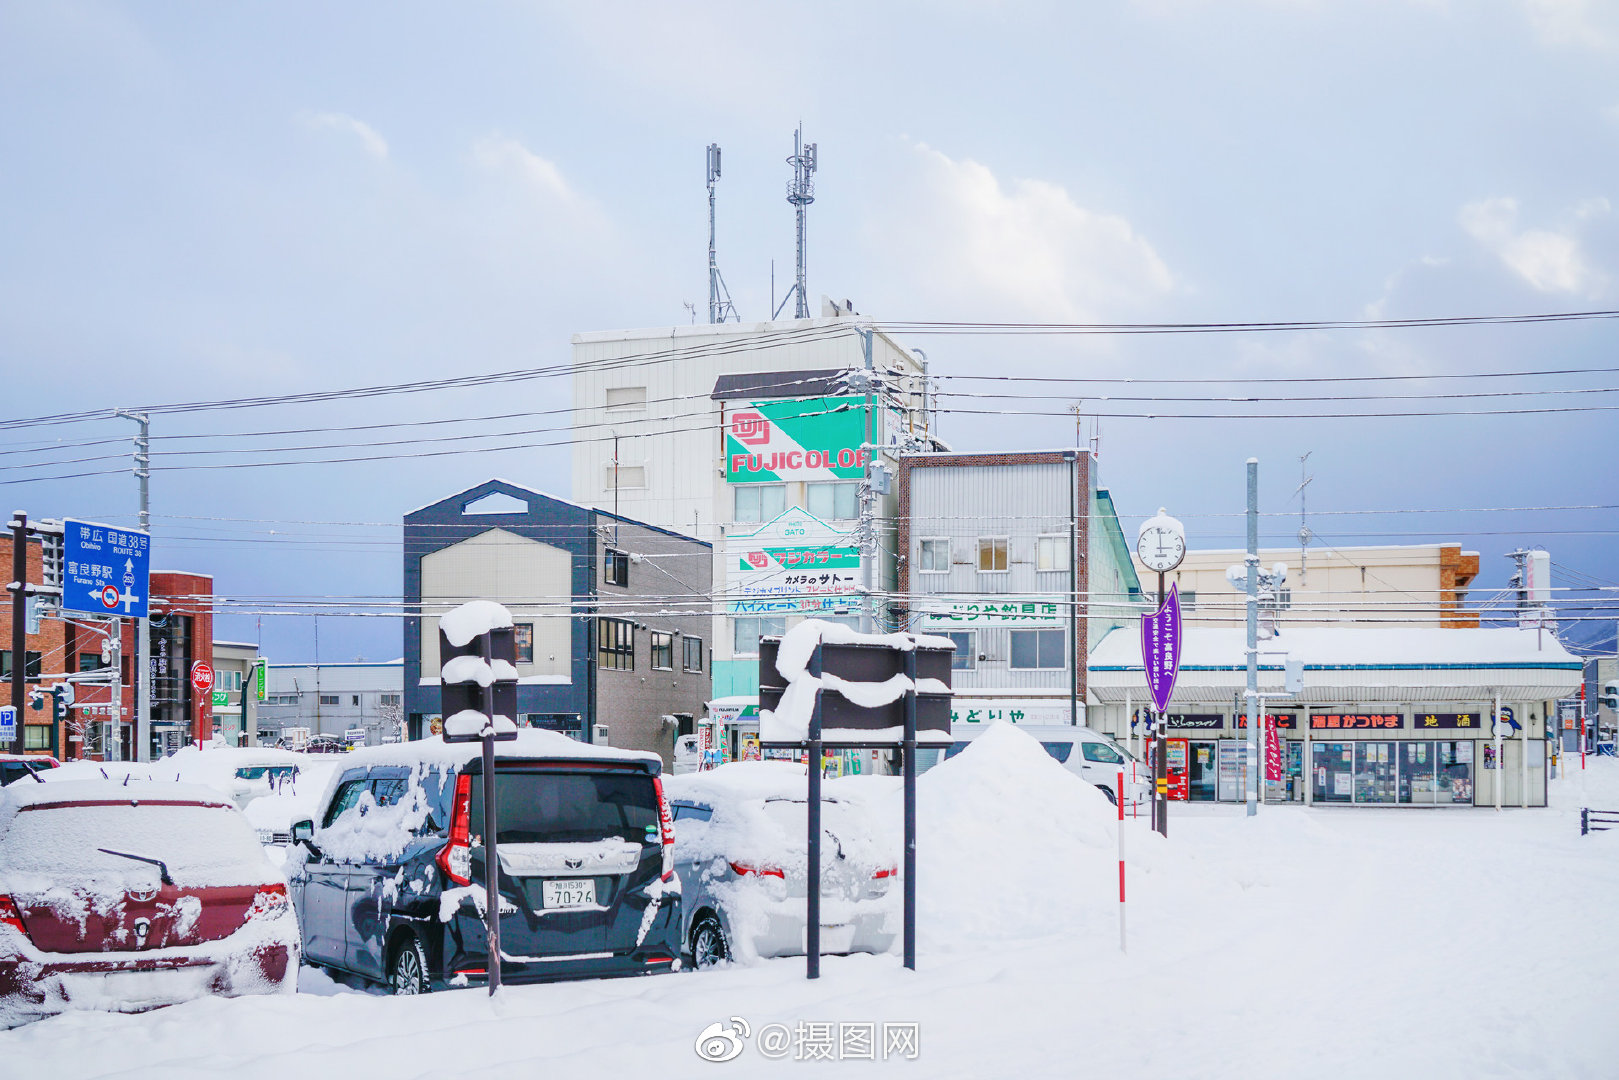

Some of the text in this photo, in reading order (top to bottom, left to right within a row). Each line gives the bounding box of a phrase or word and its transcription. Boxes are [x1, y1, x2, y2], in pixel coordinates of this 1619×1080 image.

[80, 526, 148, 550] 帯広 国道38号
[80, 541, 102, 551] Obihiro
[113, 546, 142, 558] ROUTE 38
[773, 551, 842, 565] フジカラー
[68, 561, 113, 580] 富良野駅
[73, 575, 94, 586] Furano
[1312, 715, 1399, 729] 酒屋かつやま
